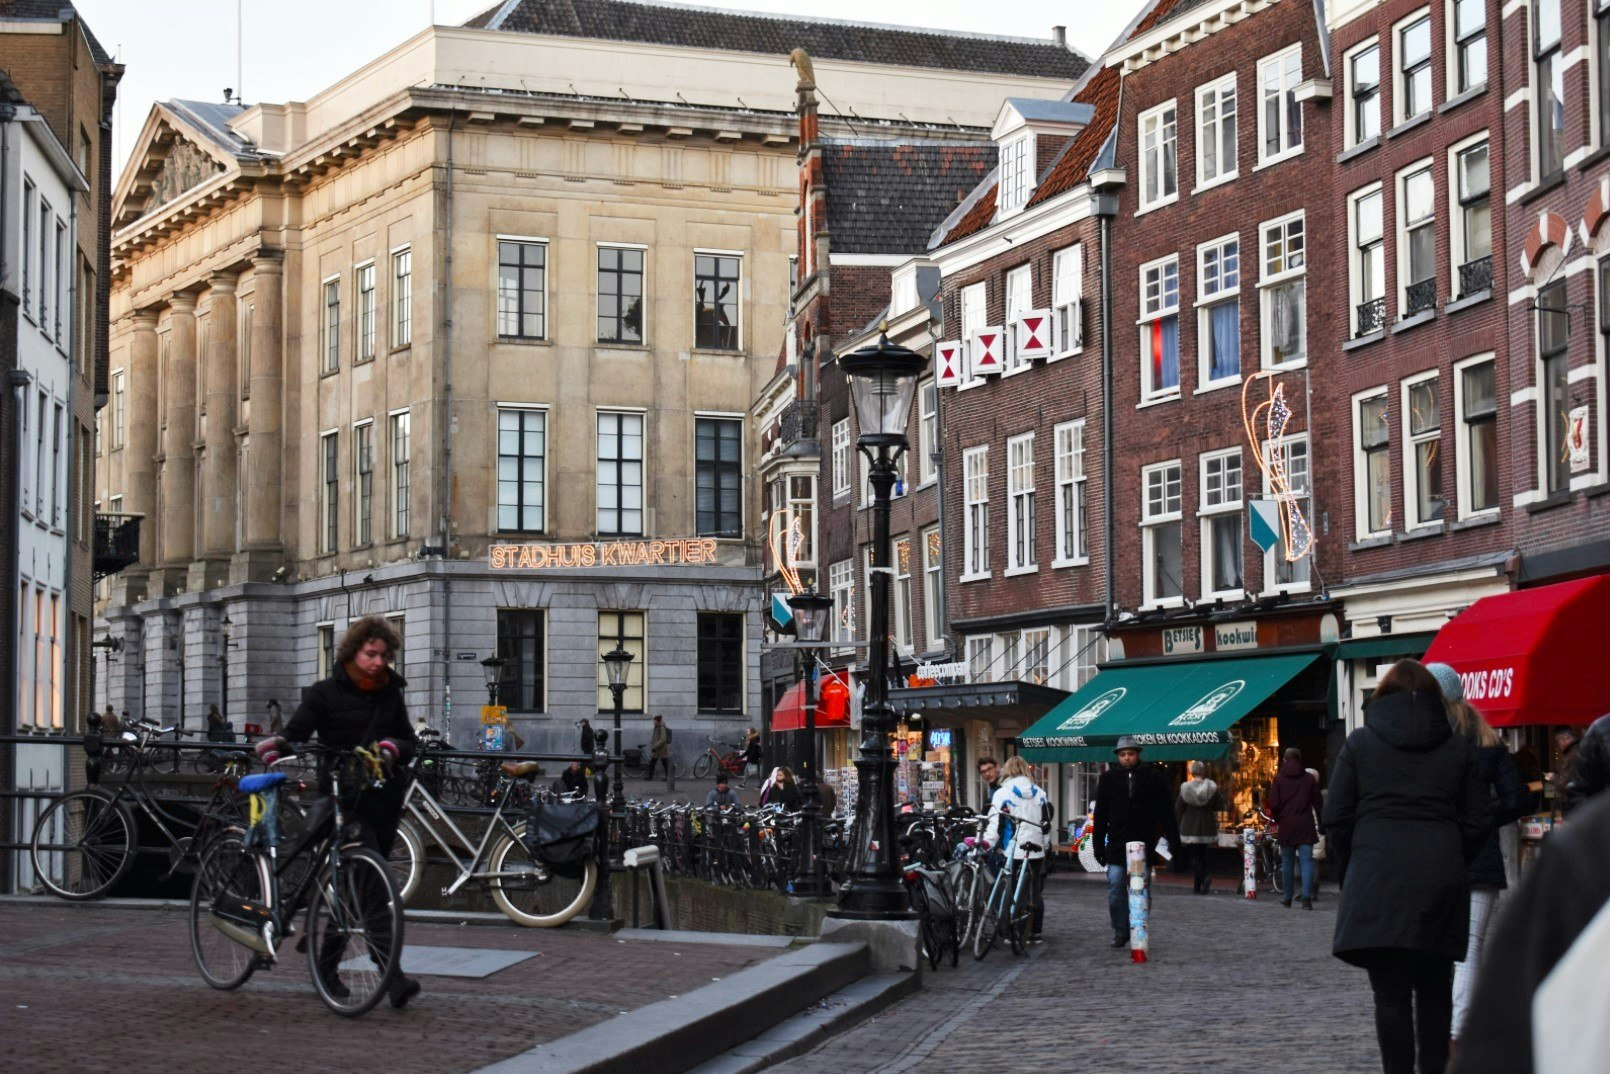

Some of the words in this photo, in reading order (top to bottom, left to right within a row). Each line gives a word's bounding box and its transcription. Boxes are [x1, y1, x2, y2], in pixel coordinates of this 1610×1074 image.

[491, 544, 595, 568] STADHUIS
[601, 539, 716, 566] KWARTIER
[1164, 625, 1200, 653] BETSIES
[1457, 670, 1488, 700] OOKS
[1488, 667, 1514, 698] CD'S
[1156, 733, 1167, 744] EN
